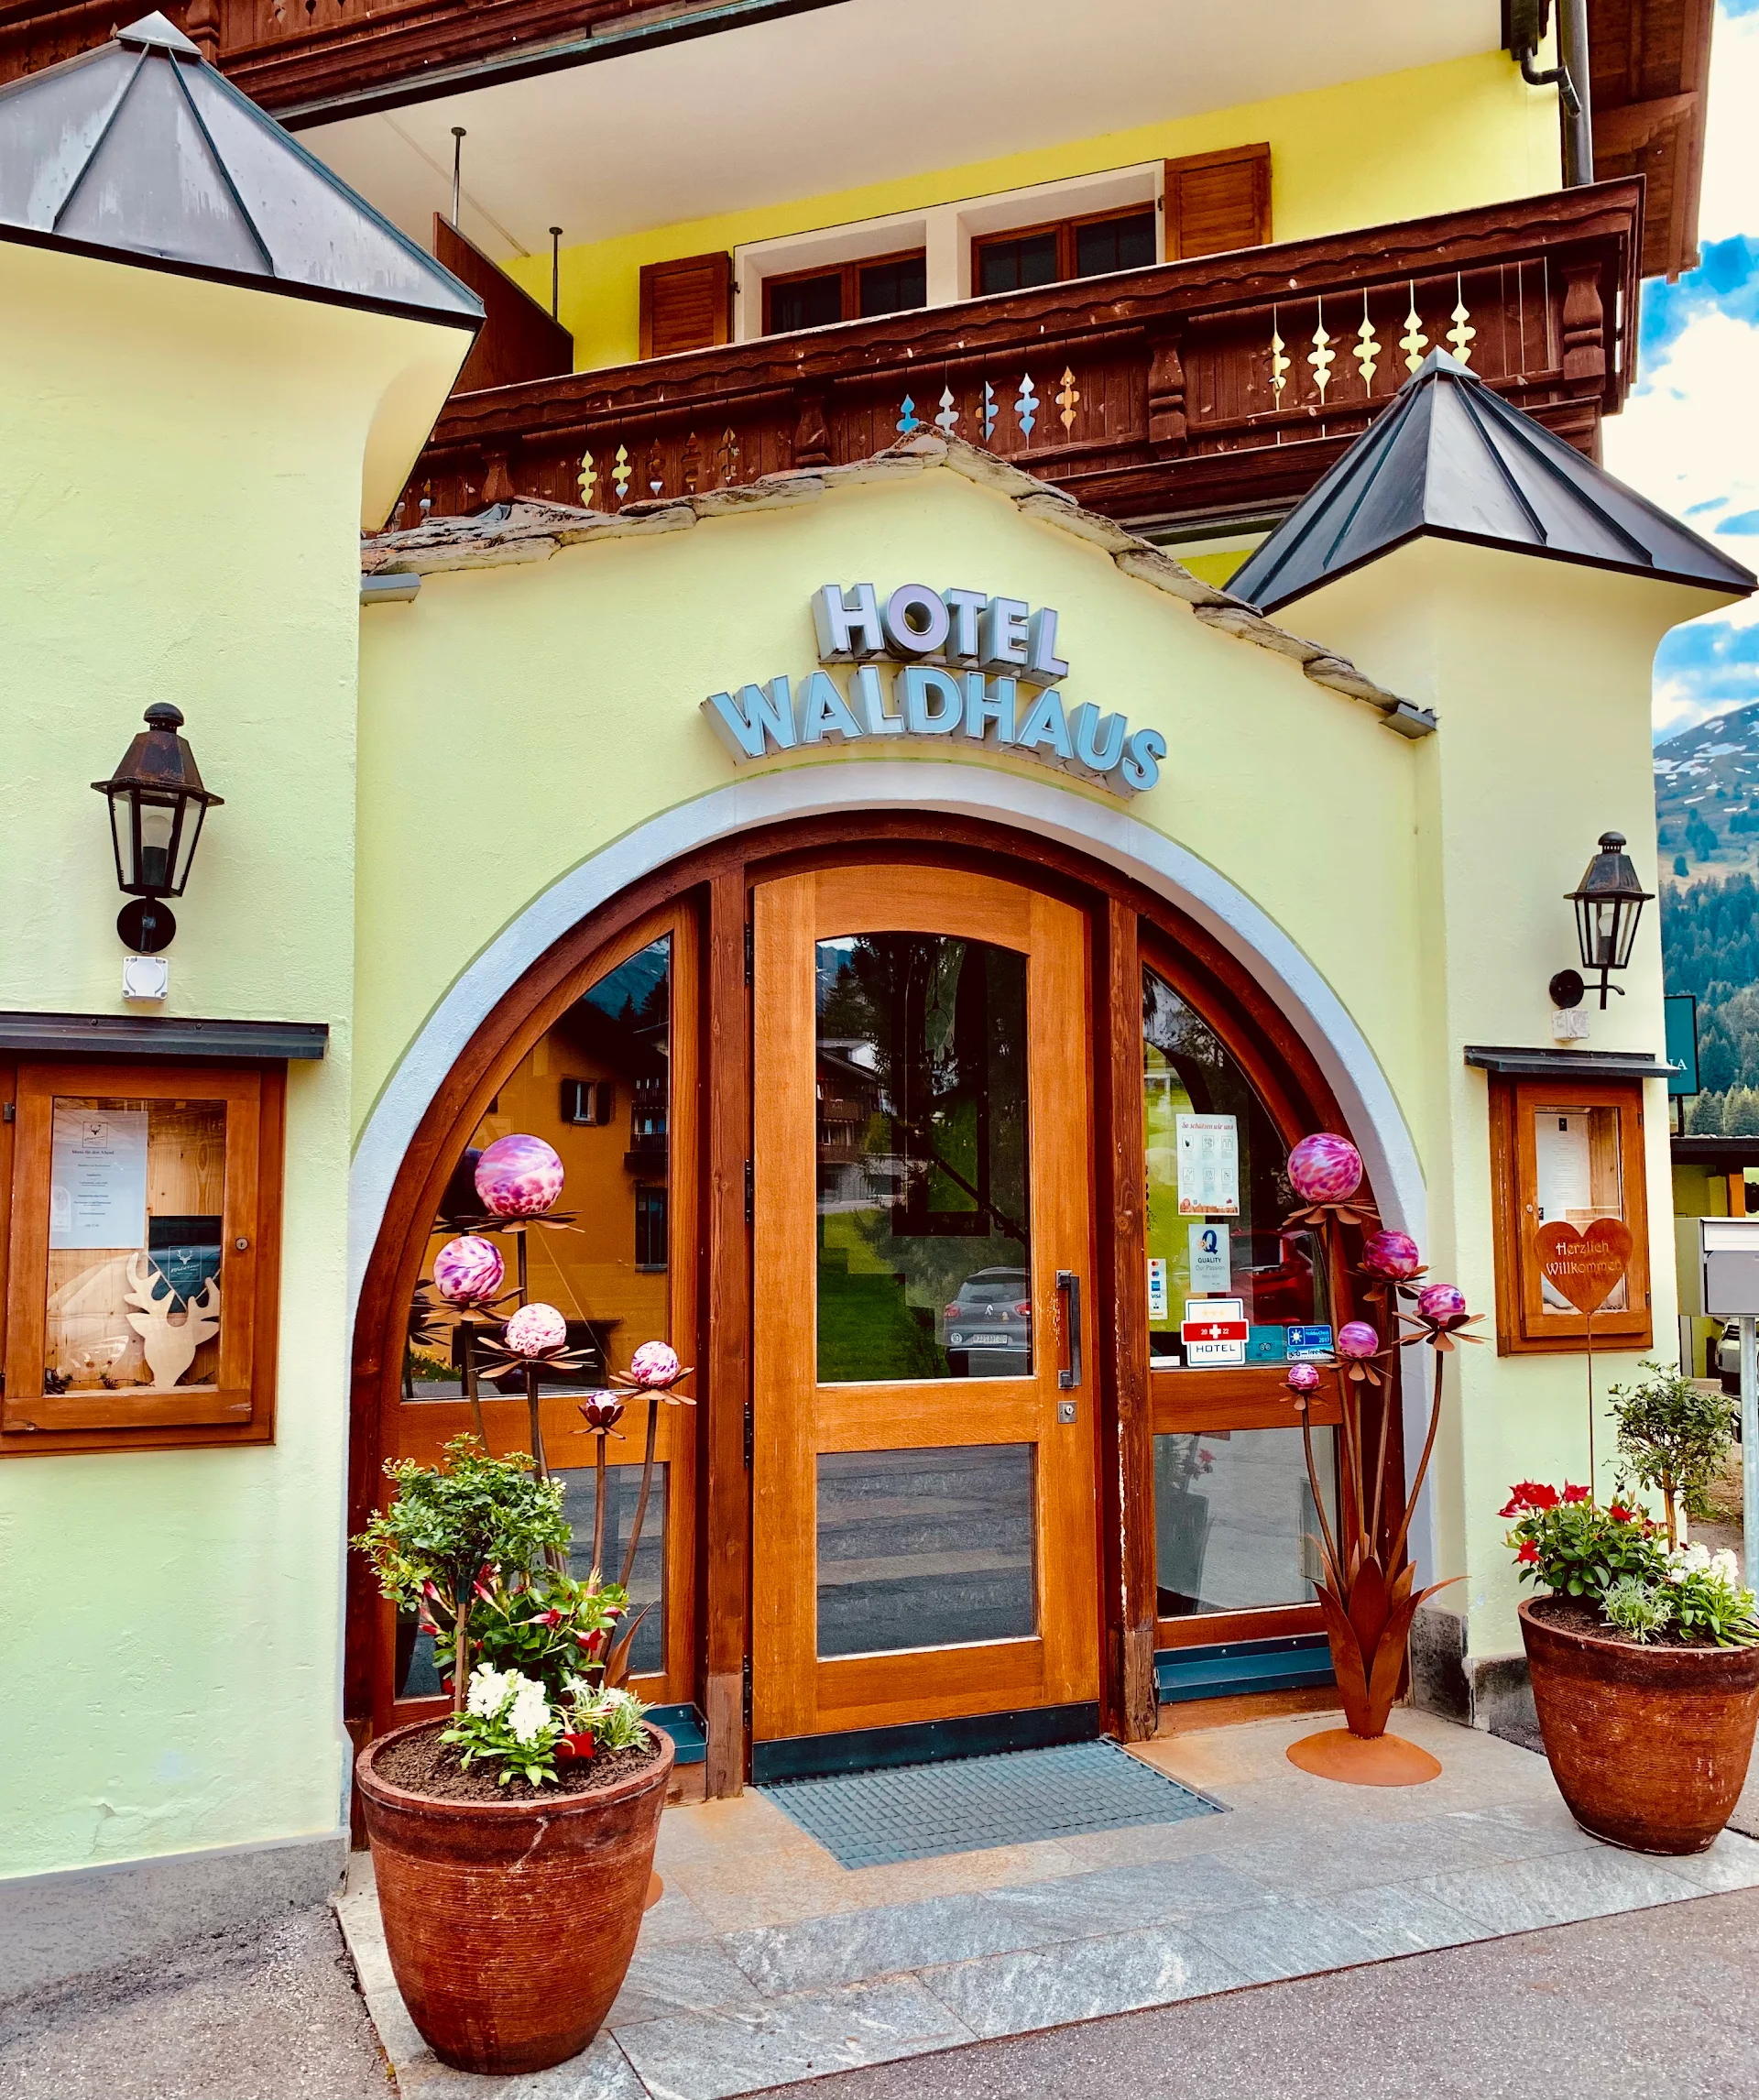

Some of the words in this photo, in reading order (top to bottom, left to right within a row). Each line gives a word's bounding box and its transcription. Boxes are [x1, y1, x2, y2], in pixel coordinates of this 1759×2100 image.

[814, 583, 1069, 680] HOTEL
[703, 665, 1167, 792] WALDHAUS
[1556, 1241, 1610, 1256] Herzlich
[1546, 1260, 1622, 1275] Willkommen
[1196, 1344, 1236, 1353] HOTEL
